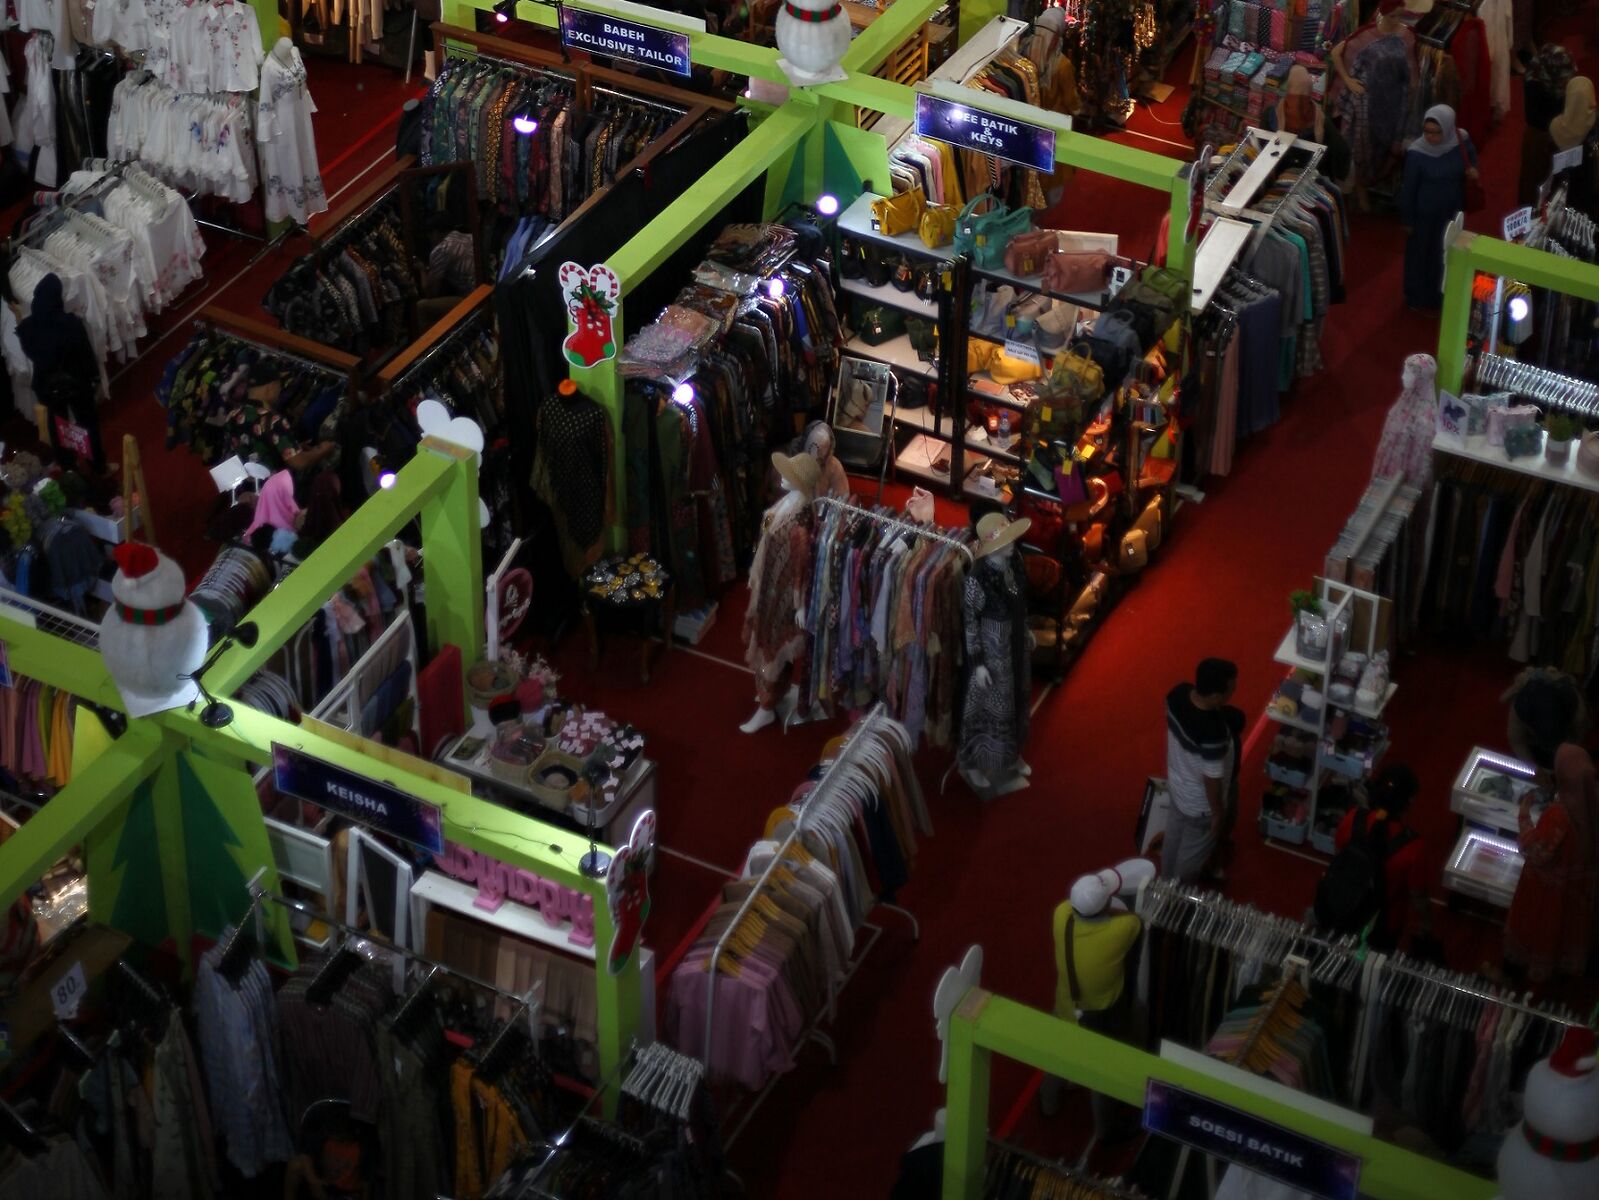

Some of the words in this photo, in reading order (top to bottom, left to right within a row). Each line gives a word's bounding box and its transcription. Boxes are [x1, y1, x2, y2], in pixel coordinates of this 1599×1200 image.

[604, 23, 645, 42] BABEH
[567, 29, 635, 54] EXCLUSIVE
[638, 47, 682, 66] TAILOR
[980, 117, 1018, 136] BATIK
[984, 127, 993, 136] &
[971, 132, 1004, 148] KEYS
[326, 781, 388, 816] KEISHA
[57, 976, 76, 1004] 80
[1188, 1114, 1243, 1145] SOESI
[1247, 1137, 1304, 1168] BATIK
